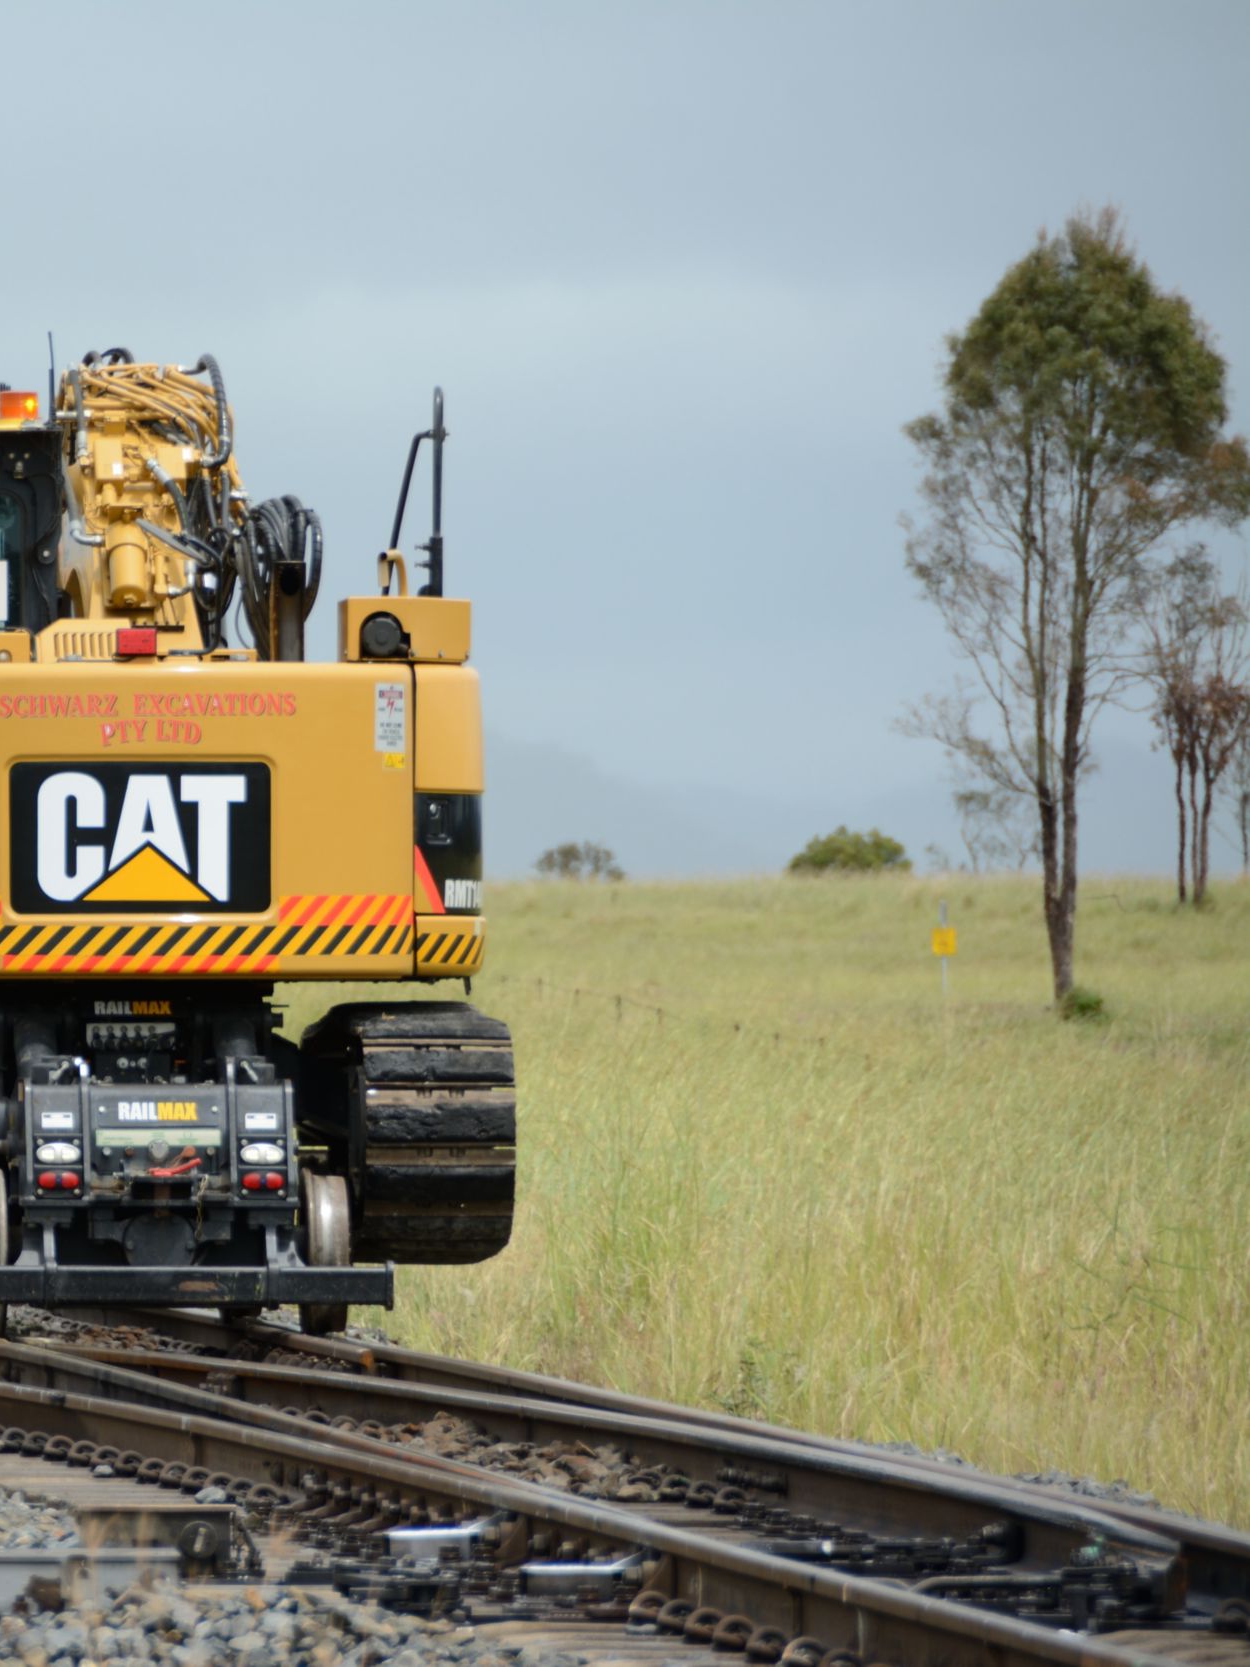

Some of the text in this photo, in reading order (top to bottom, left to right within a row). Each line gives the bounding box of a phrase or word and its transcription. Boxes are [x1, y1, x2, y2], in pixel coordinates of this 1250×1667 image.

[133, 692, 297, 717] EXCAVATIONS
[101, 719, 202, 746] PTY LTD
[37, 771, 247, 902] CAT
[94, 1000, 172, 1015] RAILMAX
[117, 1101, 198, 1121] RAILMAX
